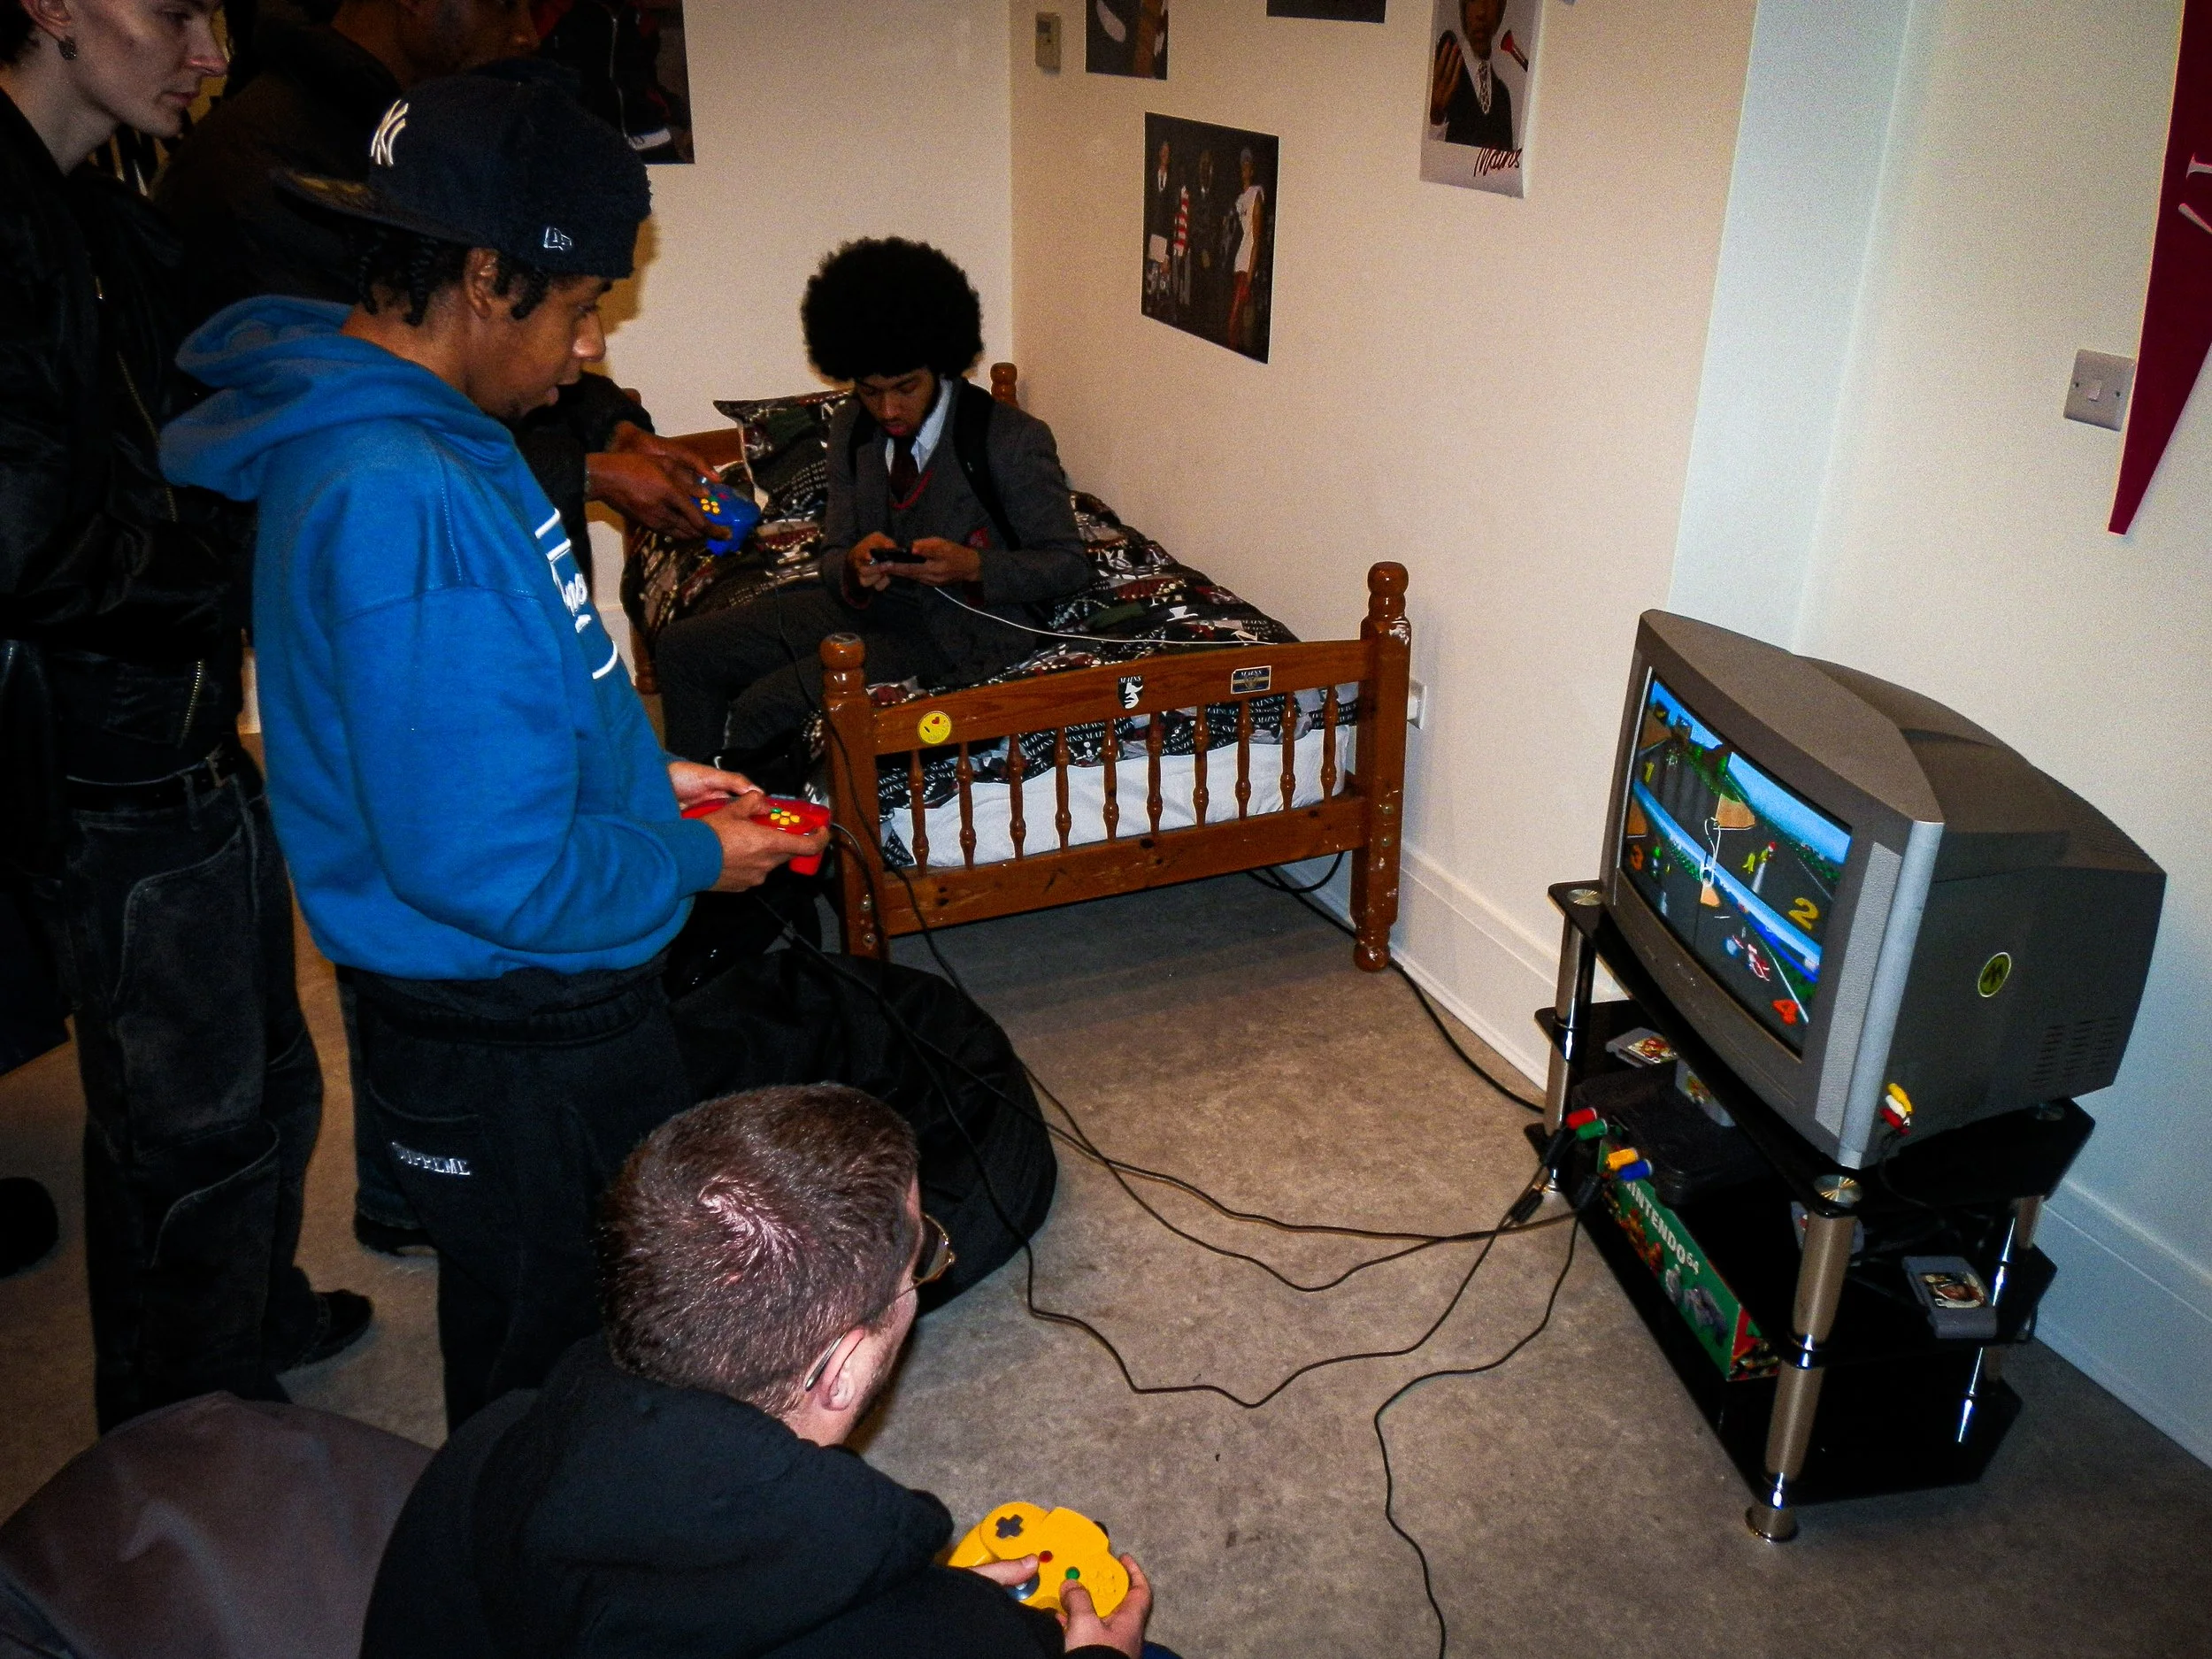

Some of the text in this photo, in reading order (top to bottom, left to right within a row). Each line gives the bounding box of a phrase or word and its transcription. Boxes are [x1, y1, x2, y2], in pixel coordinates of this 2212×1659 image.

[1473, 147, 1523, 177] Mains
[1788, 897, 1820, 931] 2
[1772, 998, 1800, 1025] 4
